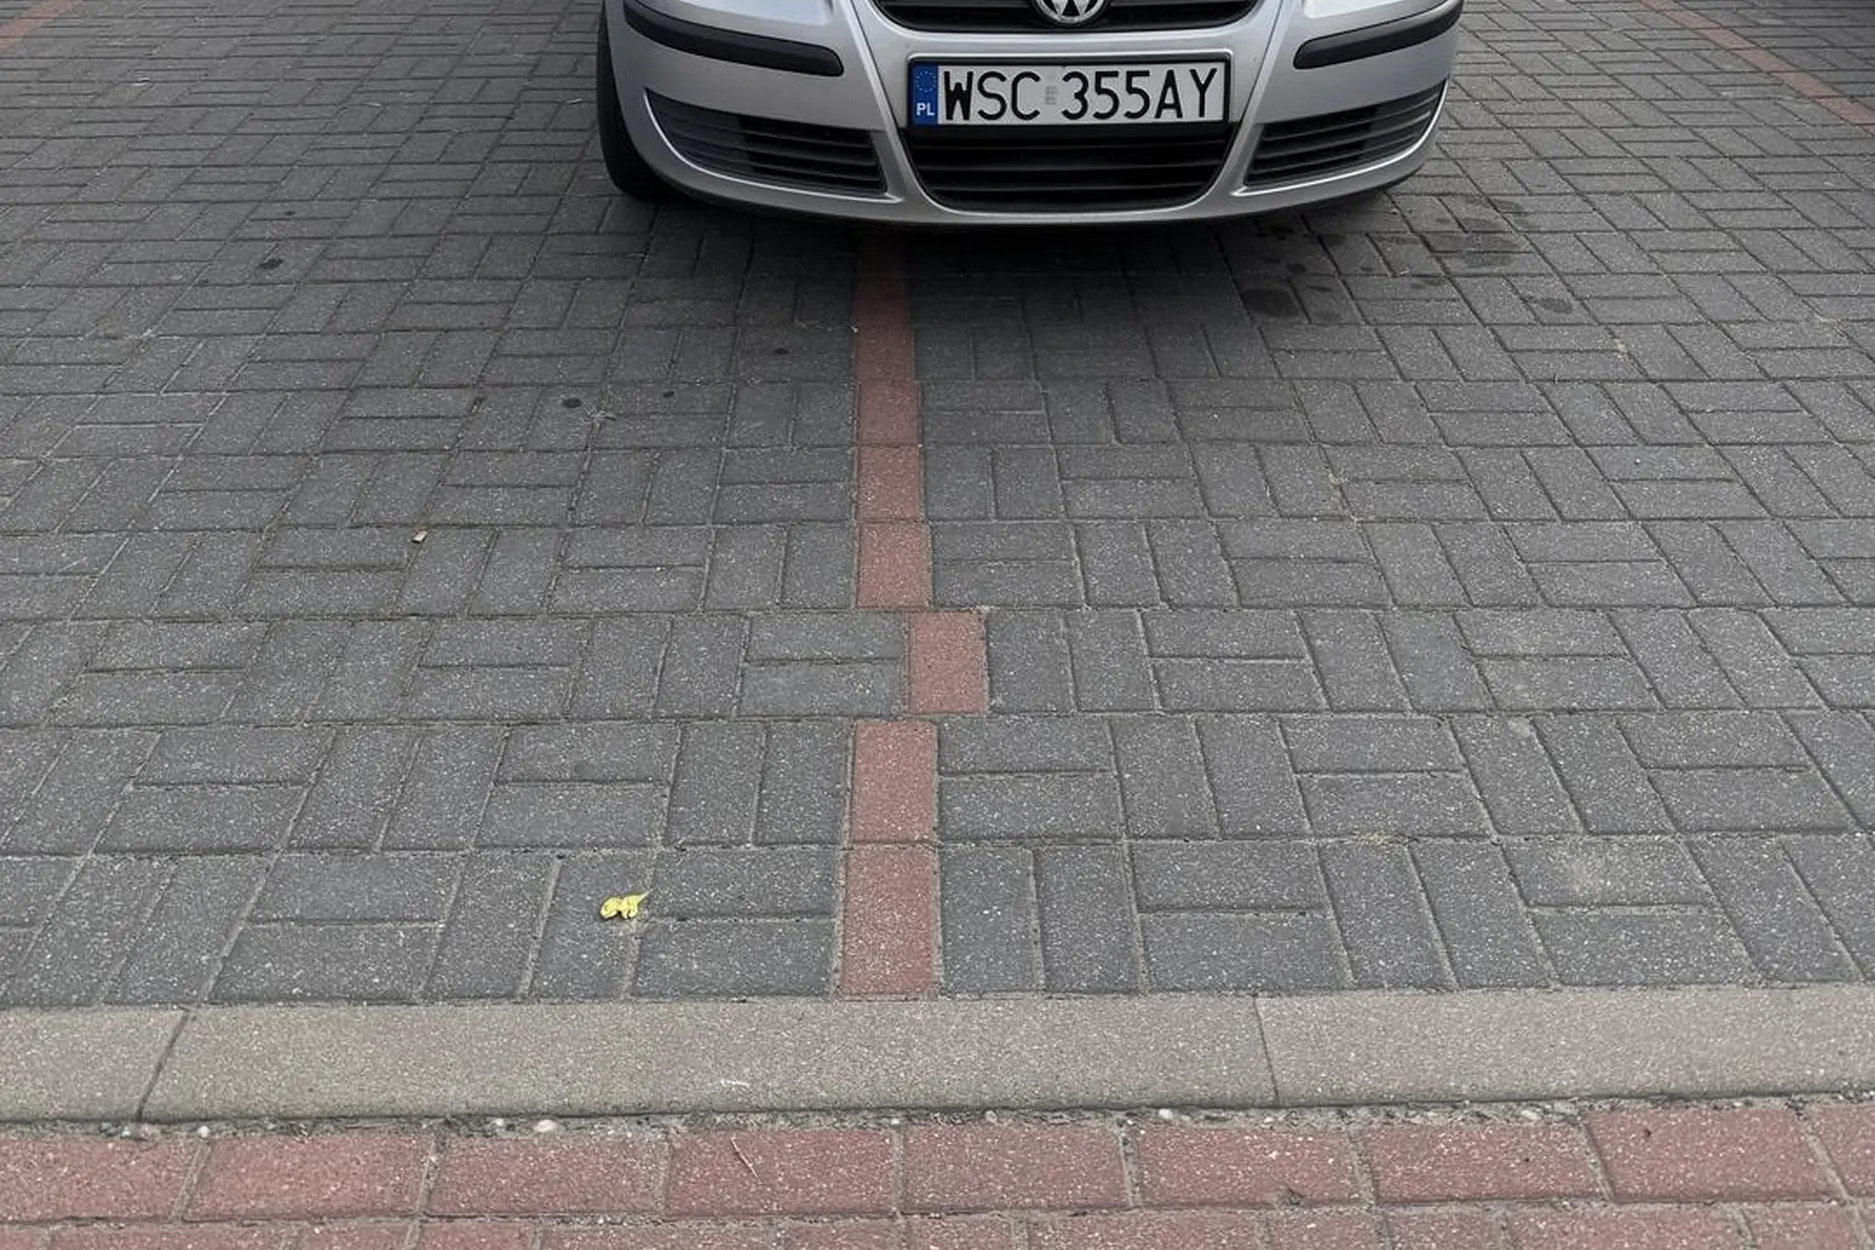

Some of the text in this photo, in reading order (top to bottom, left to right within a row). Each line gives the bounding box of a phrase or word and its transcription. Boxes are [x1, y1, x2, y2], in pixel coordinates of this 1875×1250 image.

[916, 103, 936, 117] PL
[943, 67, 1218, 121] WSC 355AY
